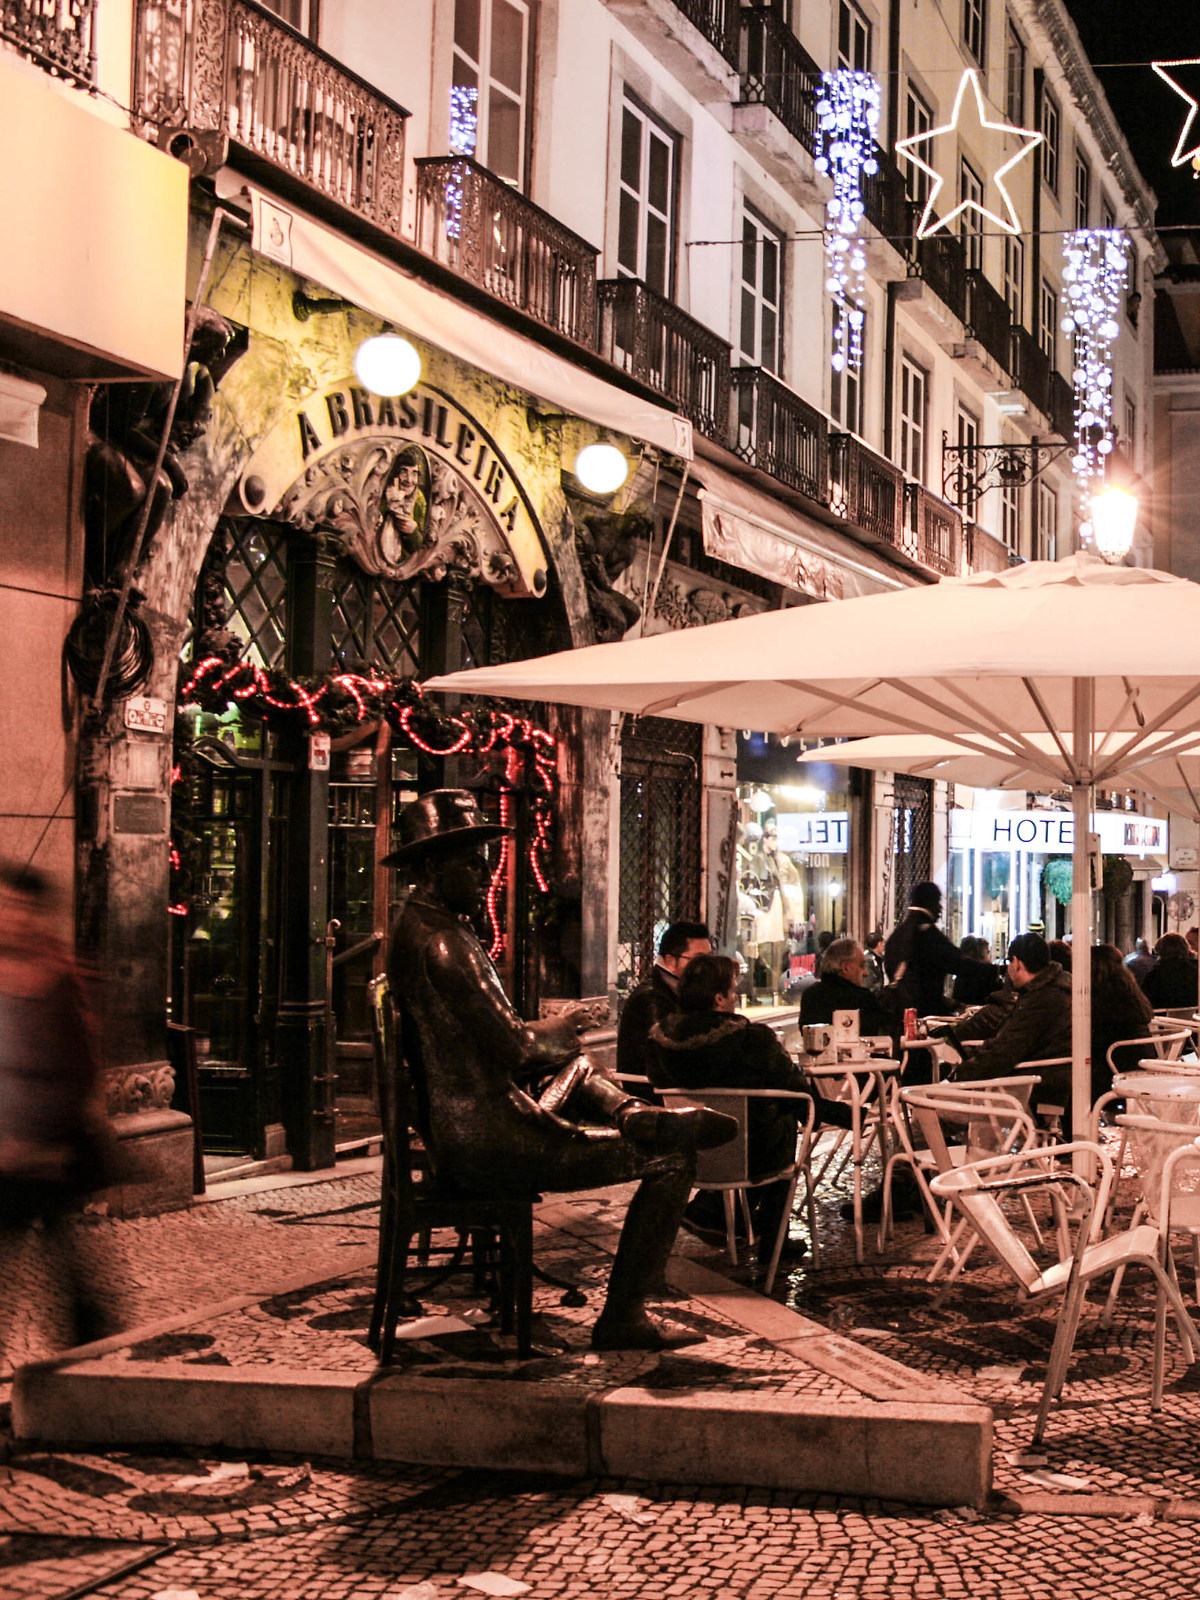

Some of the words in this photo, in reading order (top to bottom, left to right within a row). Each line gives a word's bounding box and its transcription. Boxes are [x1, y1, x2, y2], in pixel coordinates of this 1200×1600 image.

[297, 411, 322, 462] A
[325, 387, 520, 531] BRASILEIRA
[993, 818, 1075, 844] HOTE
